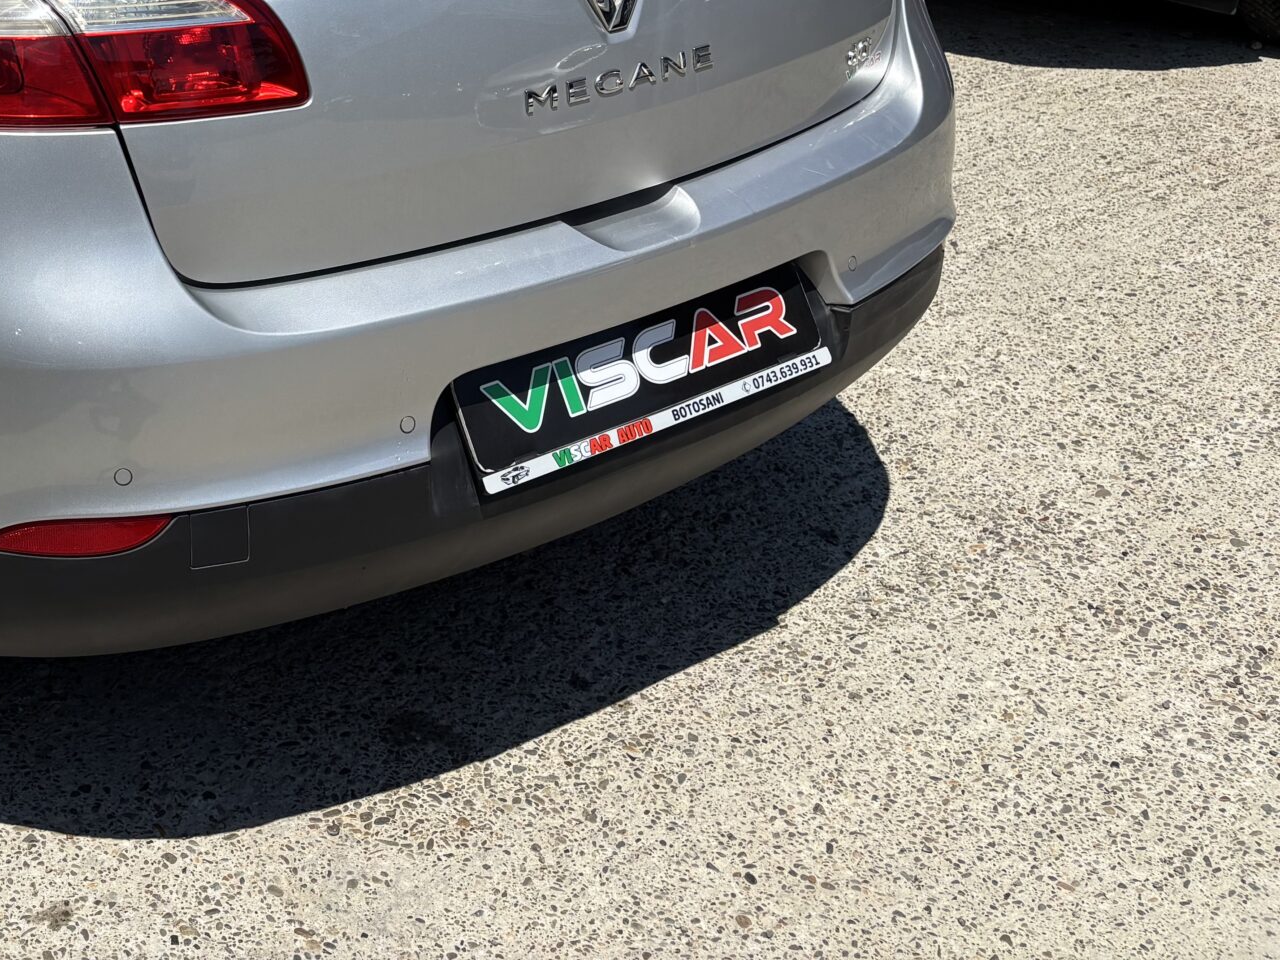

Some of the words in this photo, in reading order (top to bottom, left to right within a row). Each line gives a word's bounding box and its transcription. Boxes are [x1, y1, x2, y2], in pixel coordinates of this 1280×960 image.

[524, 44, 714, 117] MEGANE
[480, 287, 797, 434] VISCAR
[551, 433, 613, 468] VISCAR
[617, 417, 654, 445] AUTO
[671, 391, 724, 421] BOTOSANI
[752, 354, 821, 390] 0743.639.931
